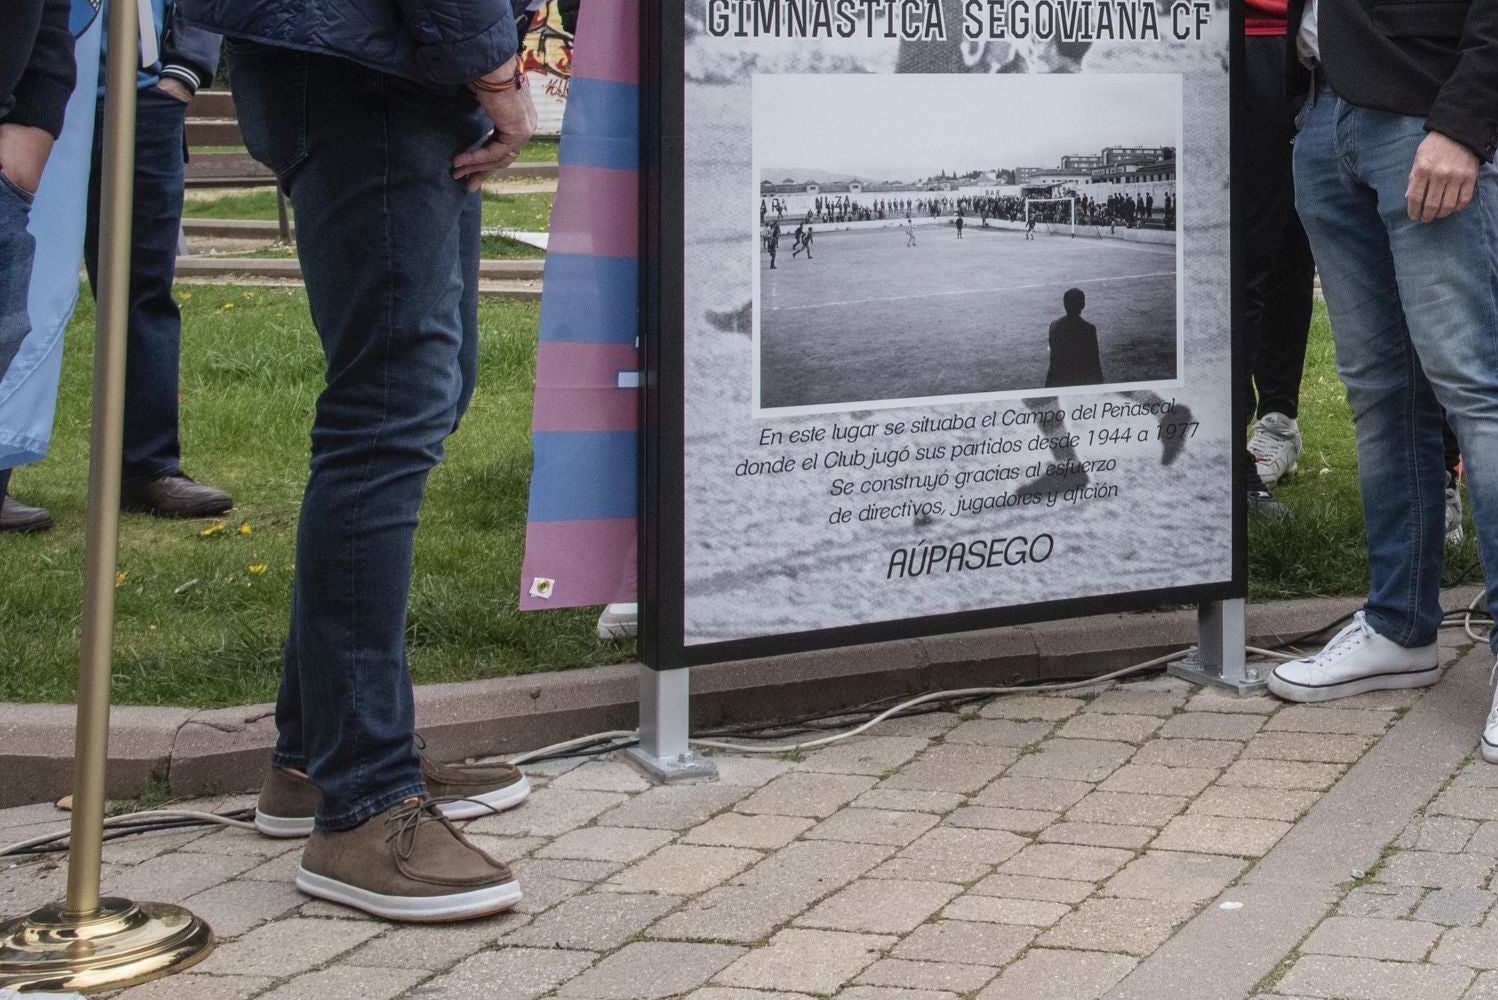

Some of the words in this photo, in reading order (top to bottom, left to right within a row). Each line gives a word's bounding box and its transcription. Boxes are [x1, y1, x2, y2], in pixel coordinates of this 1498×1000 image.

[1172, 0, 1210, 41] CF
[759, 427, 783, 446] En
[788, 426, 826, 444] este
[831, 423, 879, 444] lugar
[884, 421, 905, 436] se
[910, 413, 976, 434] situaba
[981, 410, 997, 428] el
[1001, 408, 1066, 427] Campo
[1071, 403, 1097, 421] del
[734, 455, 796, 477] donde
[801, 452, 818, 471] el
[823, 449, 866, 469] Club
[863, 444, 910, 470] jugó
[915, 445, 946, 461] sus
[950, 436, 1022, 461] partidos
[1027, 432, 1080, 451] desde
[1087, 427, 1132, 446] 1944
[1137, 429, 1149, 442] a
[1156, 421, 1200, 440] 1977
[830, 478, 855, 496] Se
[860, 469, 949, 494] construyó
[954, 463, 1020, 489] gracias
[1025, 461, 1041, 478] al
[1045, 457, 1117, 479] esfuerzo
[828, 506, 853, 524] de
[858, 499, 946, 522] directivos,
[949, 491, 1042, 517] jugadores
[1046, 491, 1058, 508] y
[1063, 481, 1119, 505] afición
[886, 532, 1055, 580] AÚPASEGO
